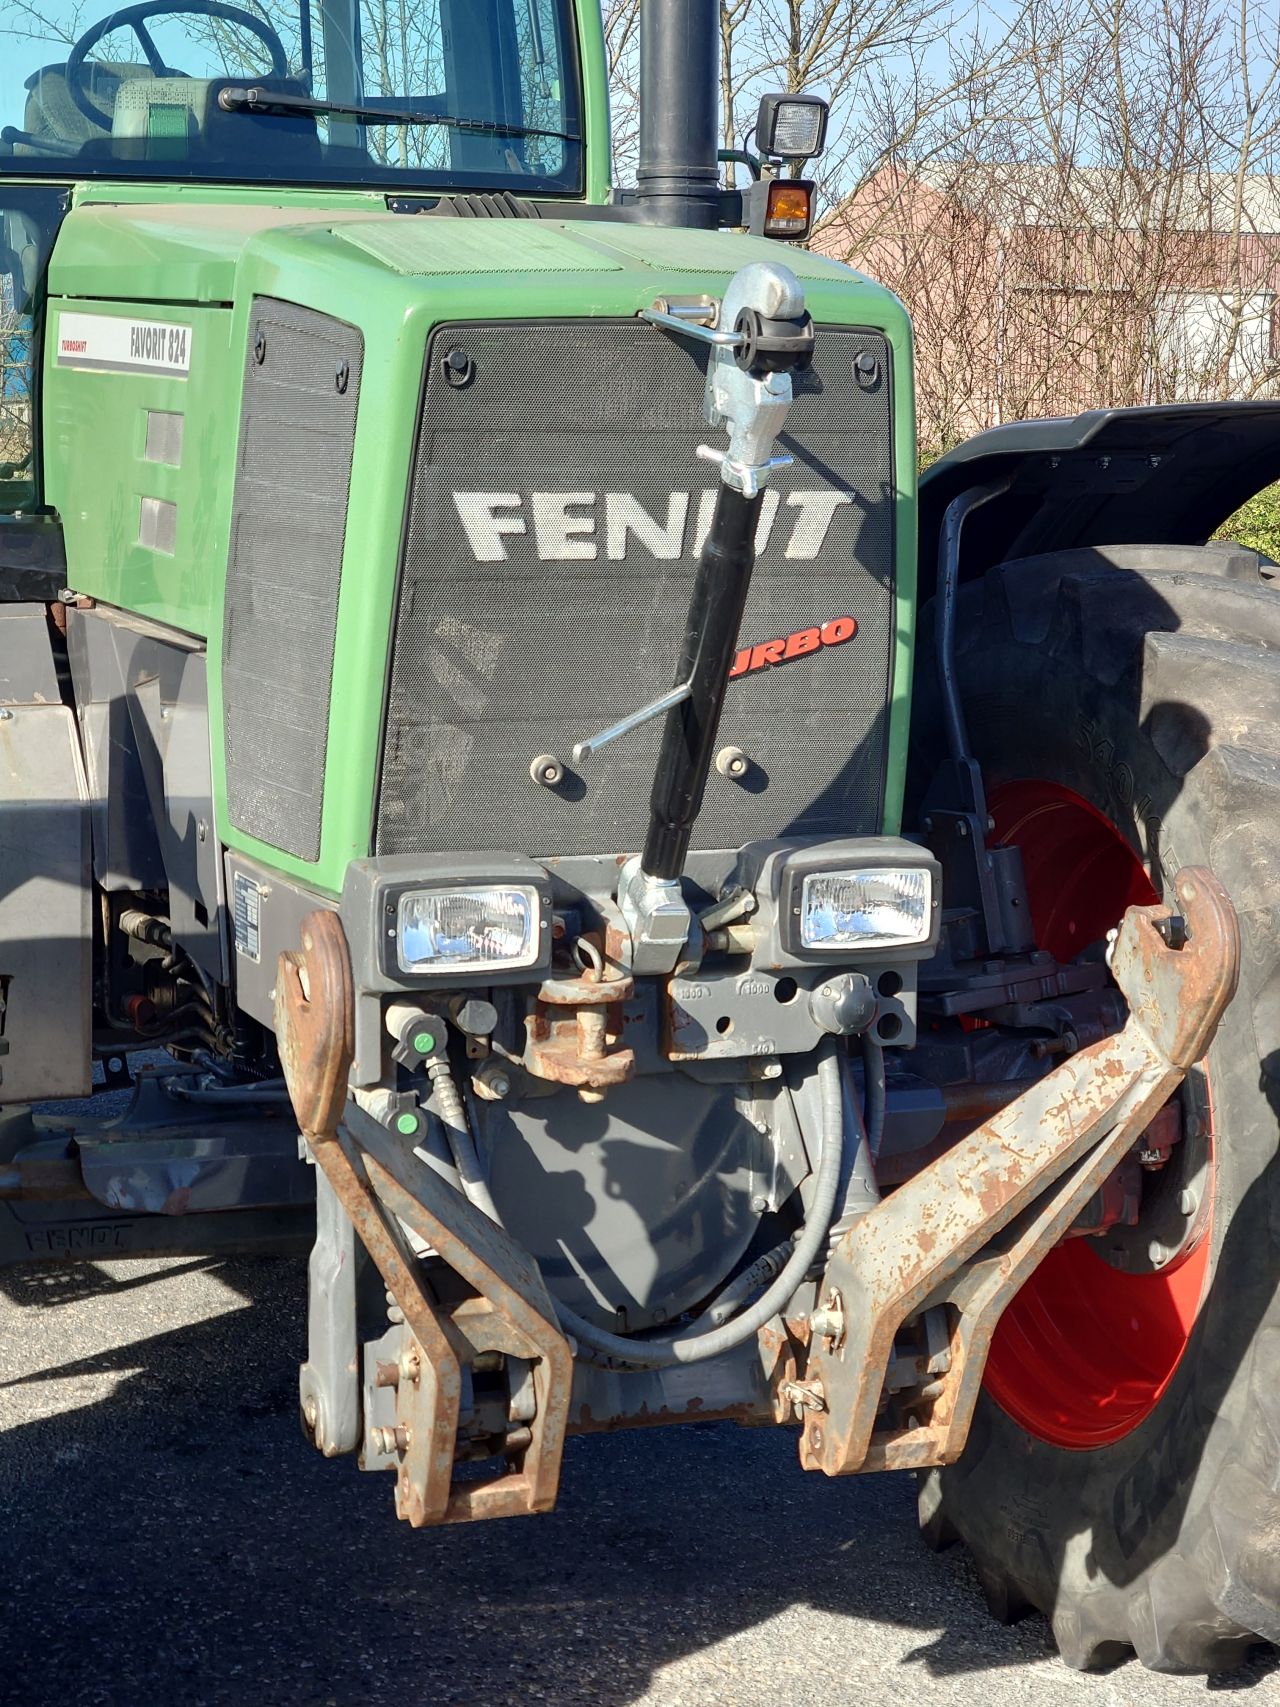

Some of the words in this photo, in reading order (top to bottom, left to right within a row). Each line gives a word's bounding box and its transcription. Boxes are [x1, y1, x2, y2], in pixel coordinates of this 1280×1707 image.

[61, 340, 87, 352] TURBOSHIFT
[130, 326, 166, 361] FAVORIT
[168, 329, 187, 364] 824
